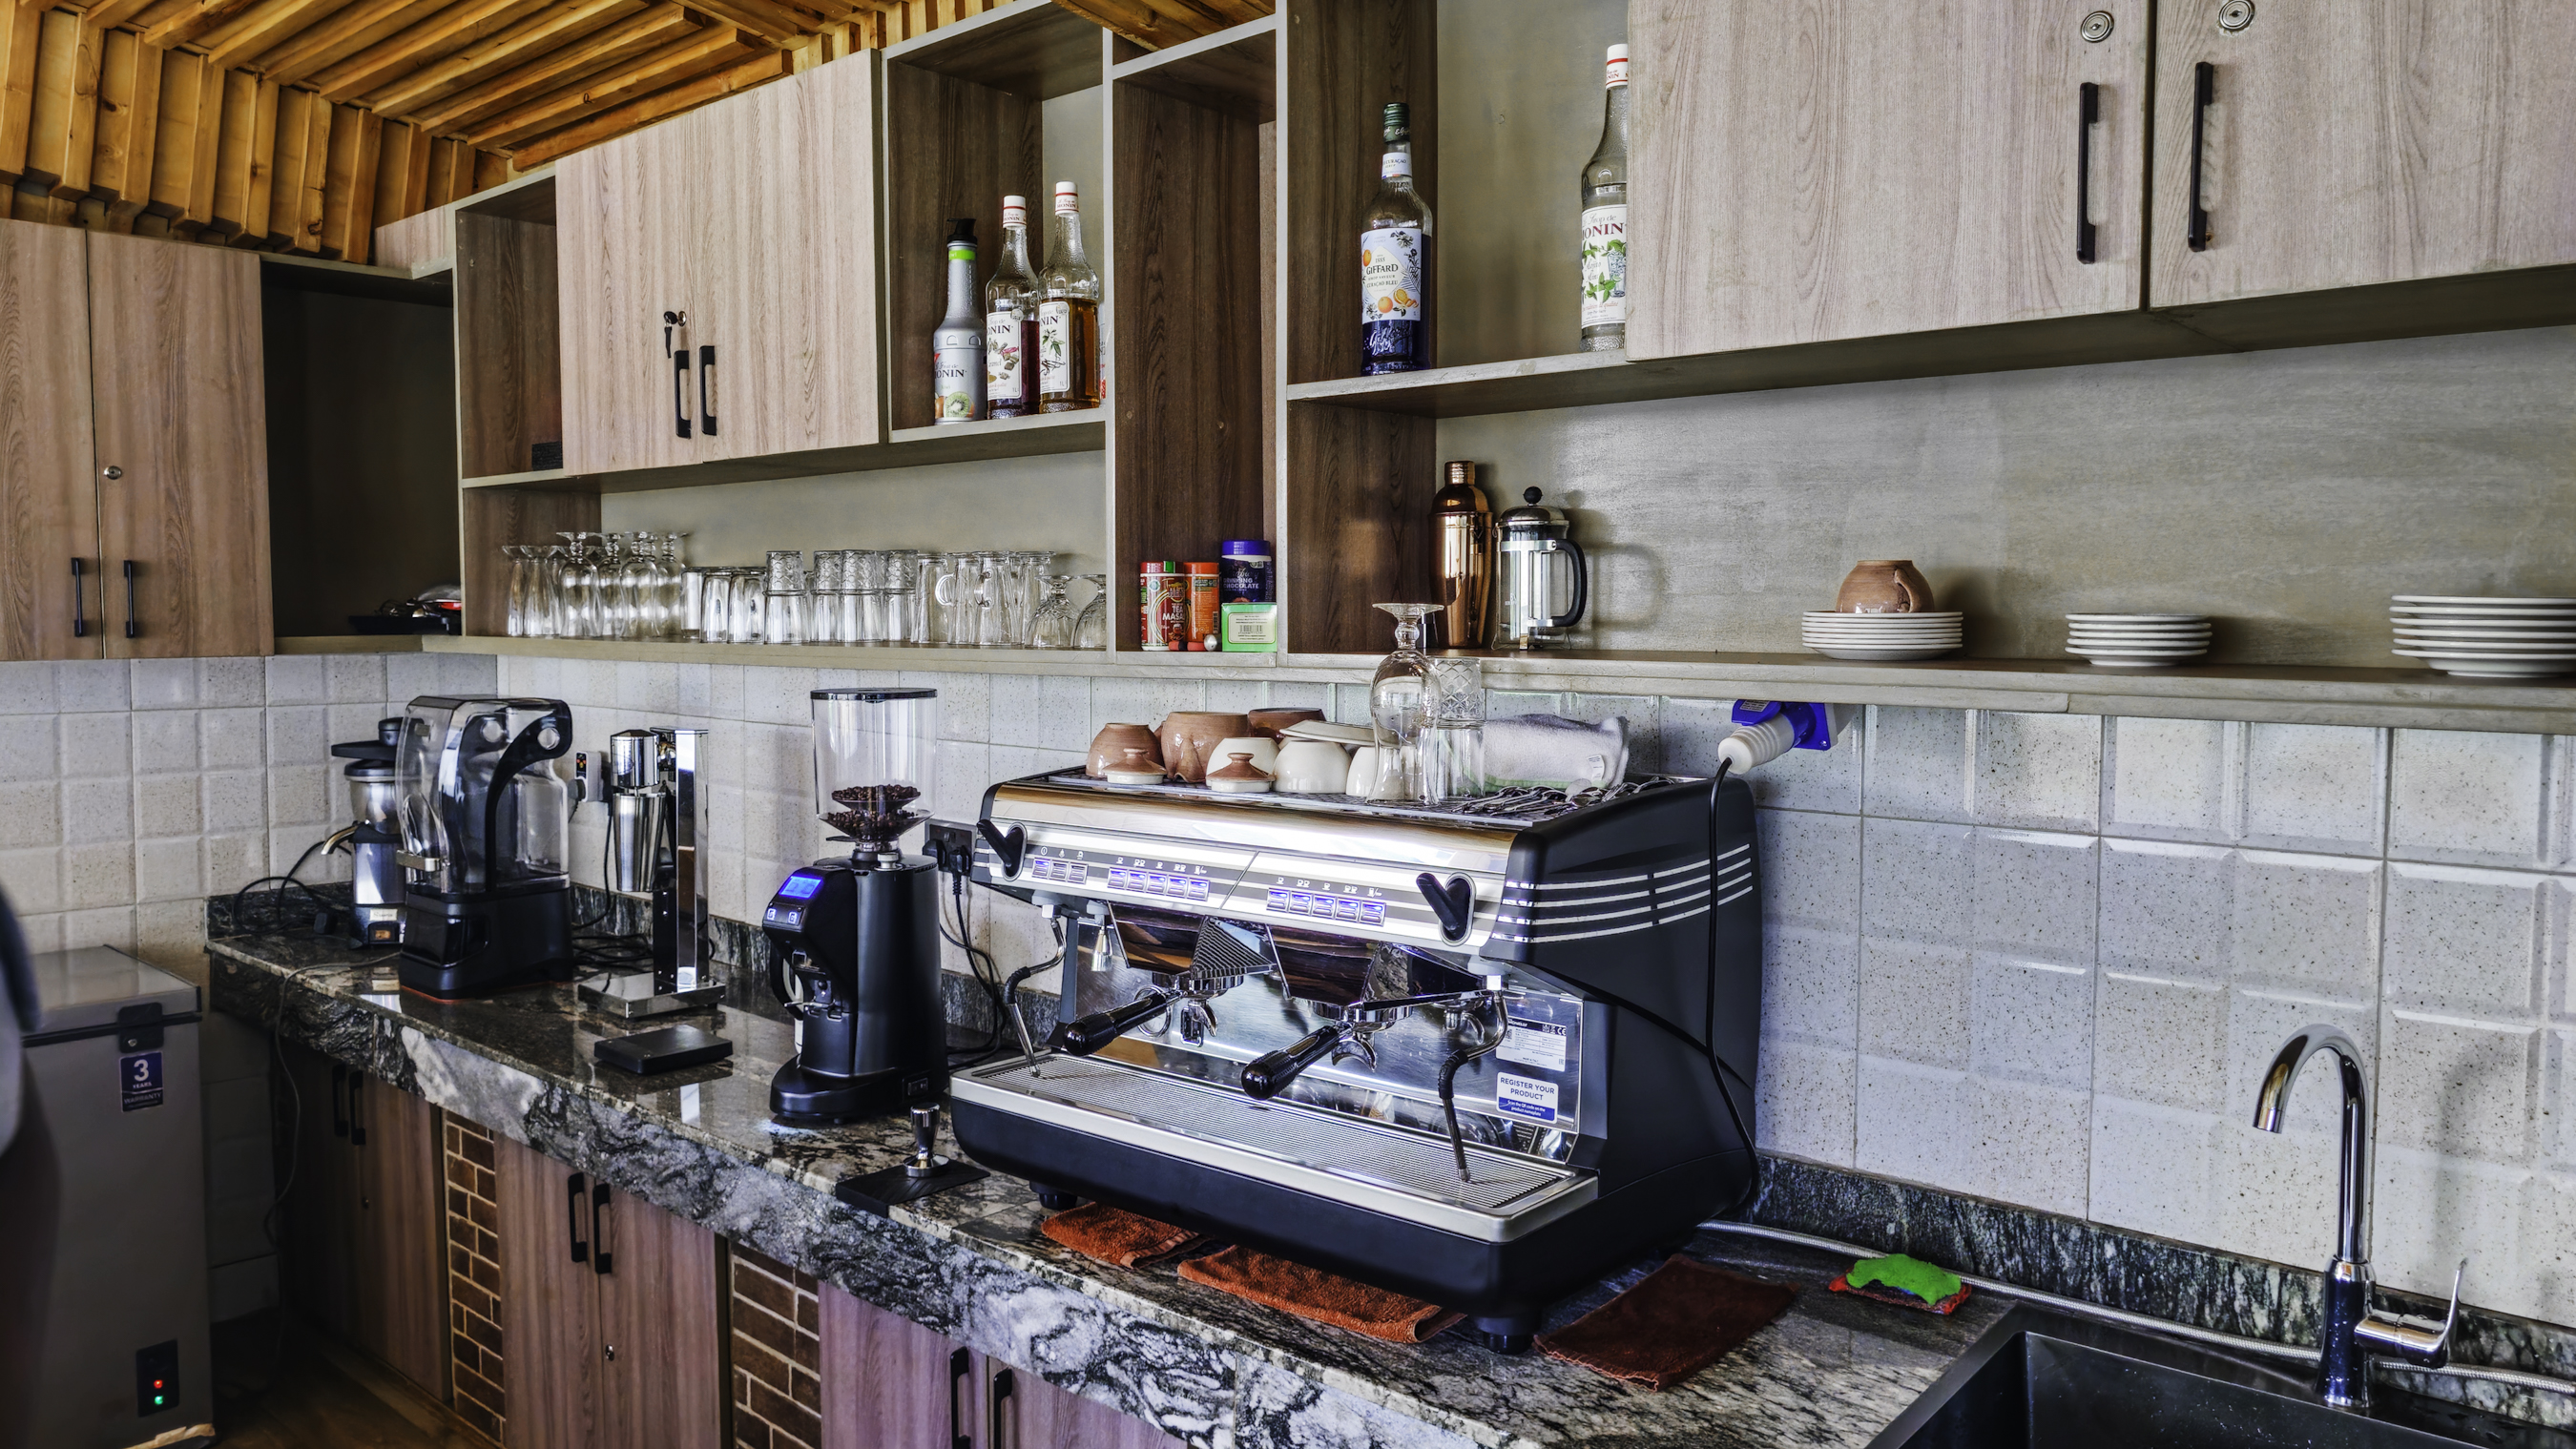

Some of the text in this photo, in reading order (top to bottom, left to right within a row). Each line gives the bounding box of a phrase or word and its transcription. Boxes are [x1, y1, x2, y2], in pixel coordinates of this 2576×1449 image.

[1582, 222, 1624, 240] ONIN
[1366, 263, 1399, 275] GIFFARD
[1040, 316, 1059, 326] NIN
[935, 369, 965, 379] ONIN
[134, 1059, 149, 1082] 3
[1500, 1077, 1555, 1094] REGISTER YOUR
[1510, 1087, 1544, 1100] PRODUCT
